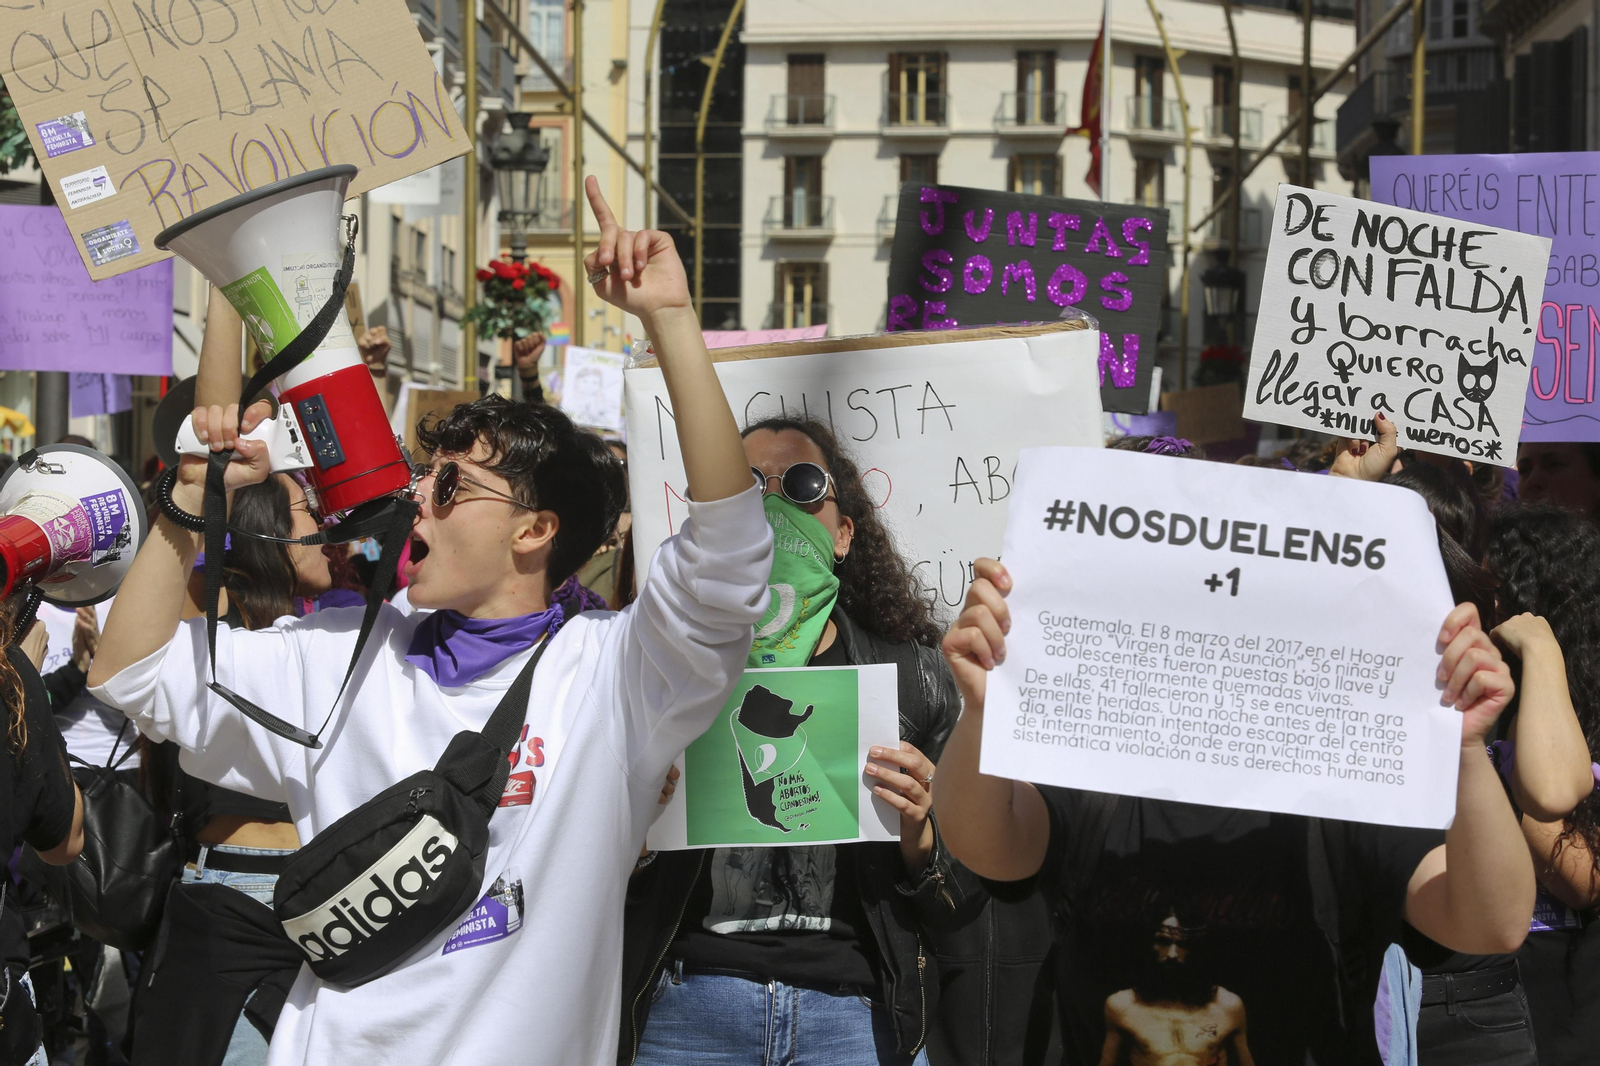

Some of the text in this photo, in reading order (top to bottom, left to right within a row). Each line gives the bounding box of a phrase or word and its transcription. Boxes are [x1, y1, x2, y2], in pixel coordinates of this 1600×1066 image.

[46, 137, 78, 151] FEMINISTA
[919, 187, 1153, 266] JUNTAS
[1285, 192, 1337, 242] DE
[918, 249, 1133, 312] SOMOS
[1288, 247, 1373, 298] CON
[1339, 302, 1528, 367] borracha
[1256, 349, 1500, 438] llegar a CASA
[105, 494, 121, 516] 8M
[949, 456, 1018, 504] AB
[89, 499, 105, 542] FEMINISTA
[98, 497, 112, 535] REVUELTA
[1043, 499, 1387, 570] #NOSDUELEN56
[1204, 567, 1241, 597] +1
[1038, 611, 1135, 636] Guatemala.
[1141, 622, 1155, 638] El
[1160, 625, 1170, 639] 8
[1175, 629, 1229, 647] marzo
[1235, 634, 1260, 650] del
[1331, 646, 1345, 660] el
[1350, 649, 1404, 668] Hogar
[1043, 626, 1102, 646] Seguro
[1174, 642, 1195, 657] de
[1201, 644, 1215, 660] la
[1311, 658, 1331, 673] 56
[1336, 662, 1379, 679] niñas
[1385, 671, 1395, 684] y
[1025, 668, 1403, 727] De ellas, 41 fallecieron y 15 se encuentran gra
[1045, 643, 1389, 698] adolescentes fueron puestas bajo llave y
[1077, 662, 1353, 706] posteriormente quemadas vivas.
[1016, 712, 1404, 770] de internamiento, donde eran víctimas de una
[1018, 686, 1407, 743] vemente heridas. Una noche antes de la trage
[1054, 703, 1092, 719] ellas
[1098, 707, 1156, 727] habían
[1161, 716, 1241, 737] intentado
[1246, 727, 1315, 746] escapar
[1320, 734, 1345, 749] del
[1350, 740, 1404, 756] centro
[1013, 728, 1405, 785] sistemática violación a sus derechos humanos
[780, 785, 810, 801] ABORTOS
[298, 835, 454, 960] adidas
